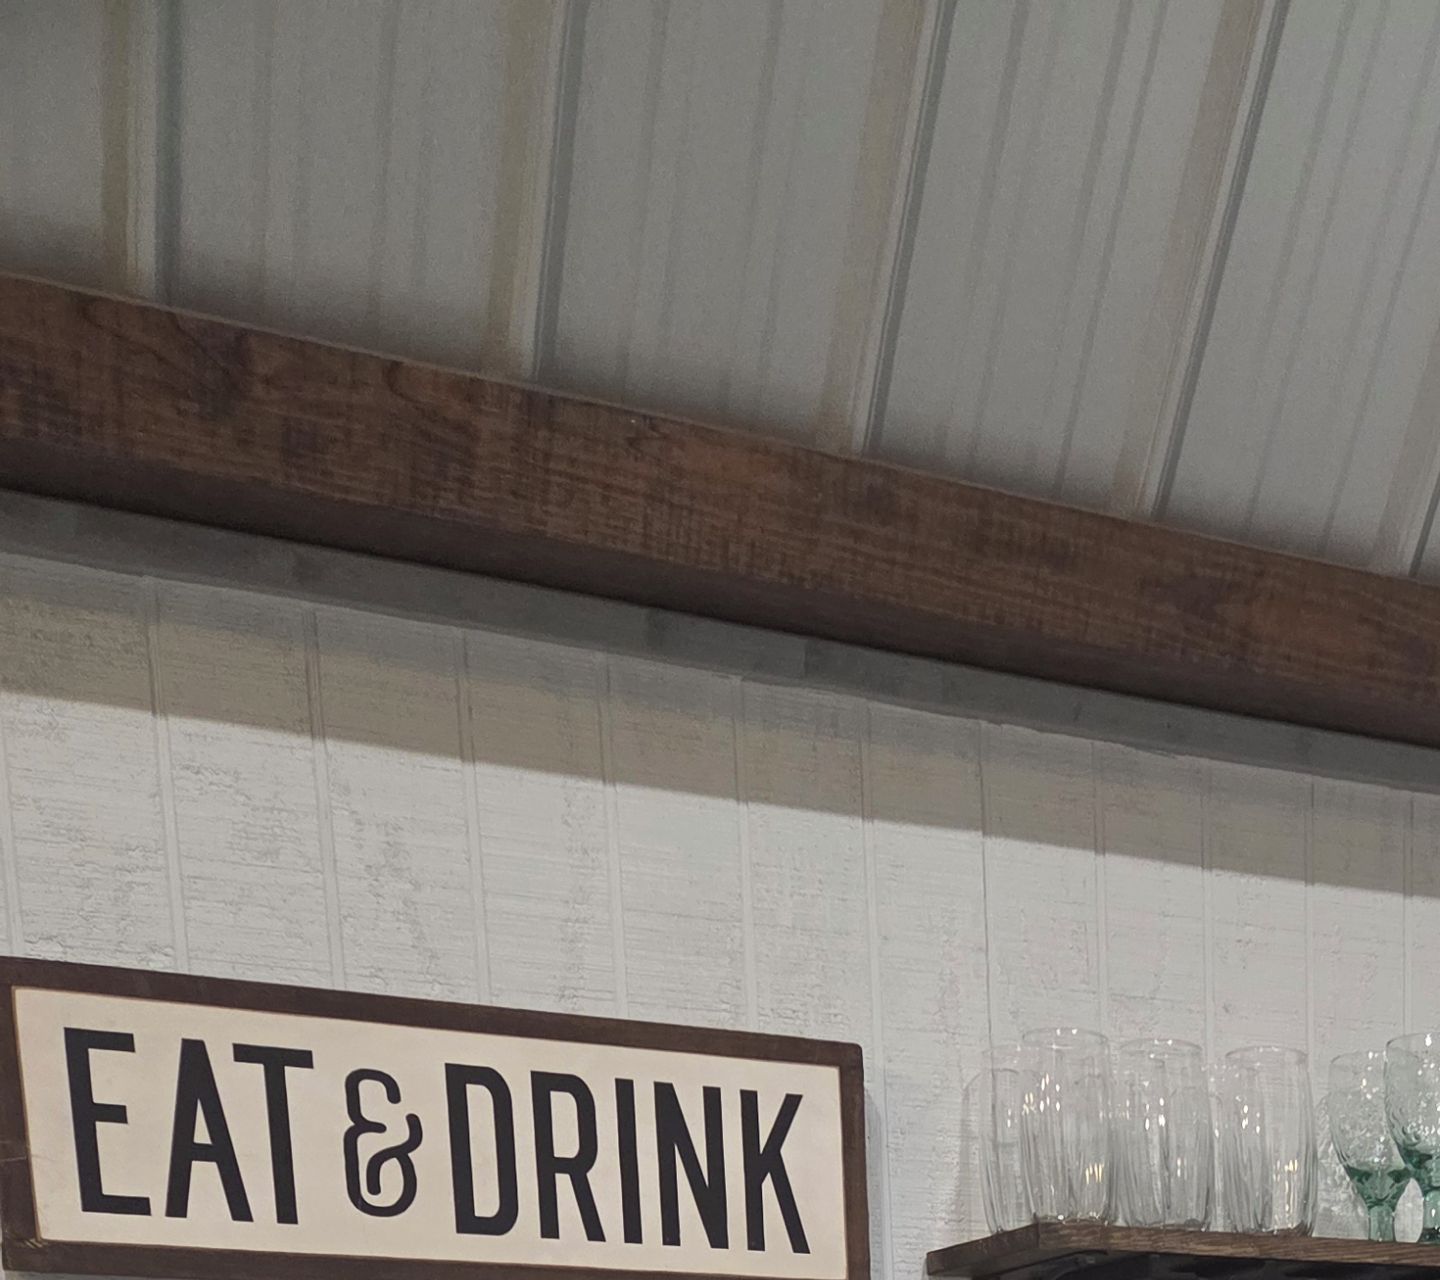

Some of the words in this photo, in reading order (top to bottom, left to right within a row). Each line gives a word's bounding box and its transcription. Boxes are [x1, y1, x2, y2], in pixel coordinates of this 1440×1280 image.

[64, 1027, 313, 1224] EAT
[344, 1068, 422, 1217] &
[444, 1062, 811, 1254] DRINK
